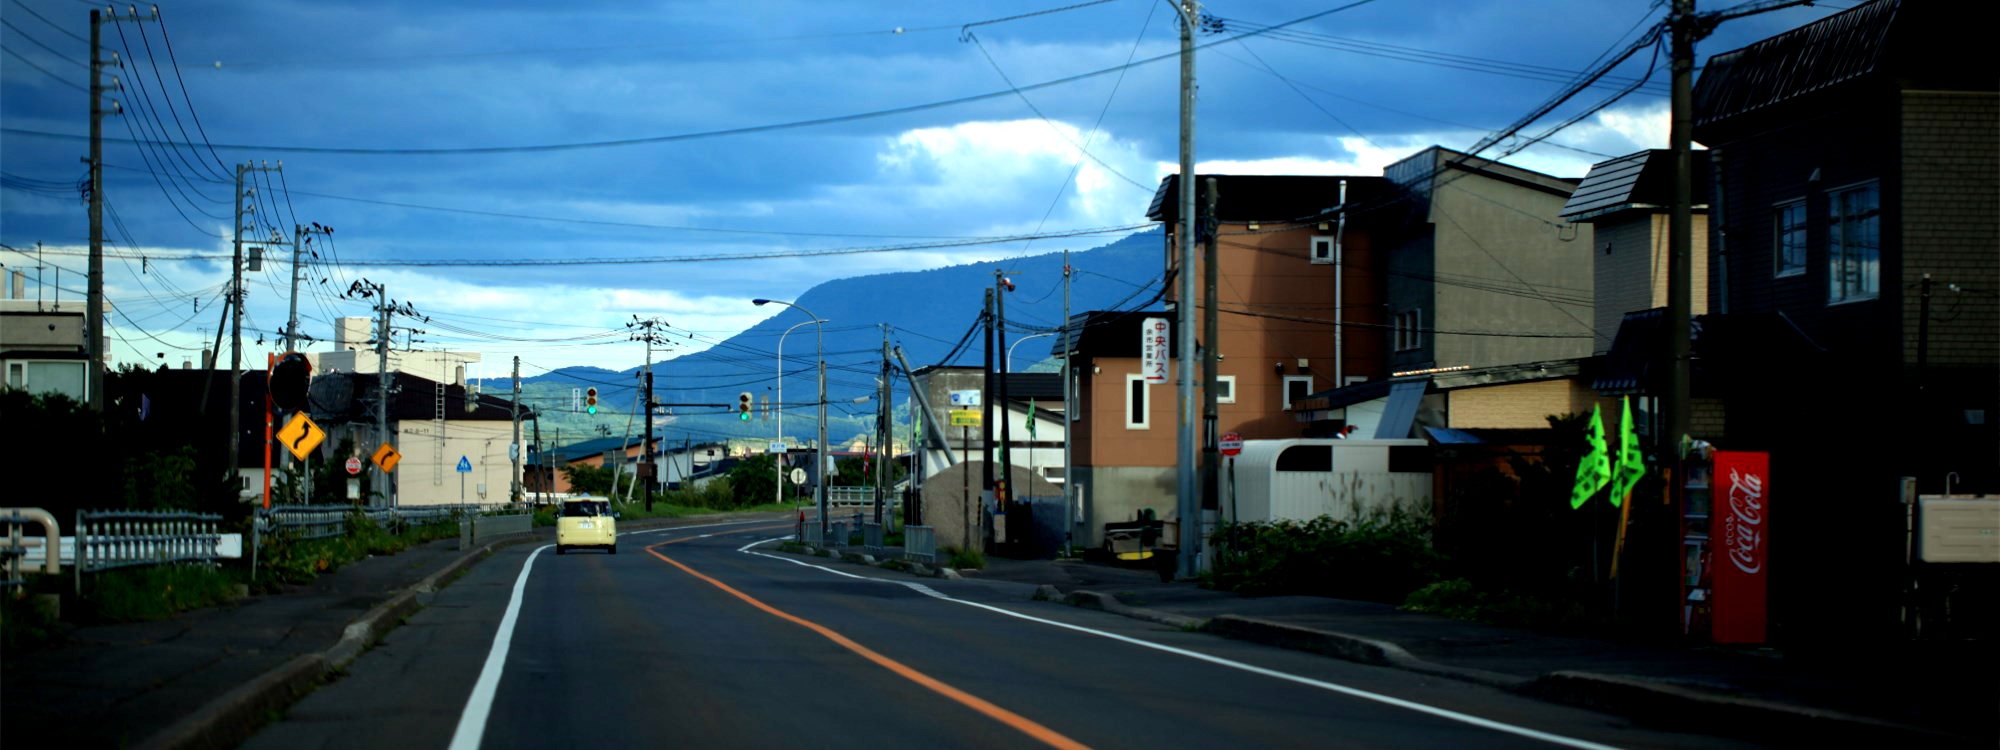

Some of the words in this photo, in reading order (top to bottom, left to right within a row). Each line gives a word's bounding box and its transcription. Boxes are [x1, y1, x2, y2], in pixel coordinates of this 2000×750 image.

[1155, 323, 1167, 373] 中央バス
[1729, 468, 1762, 574] Coca-Cola
